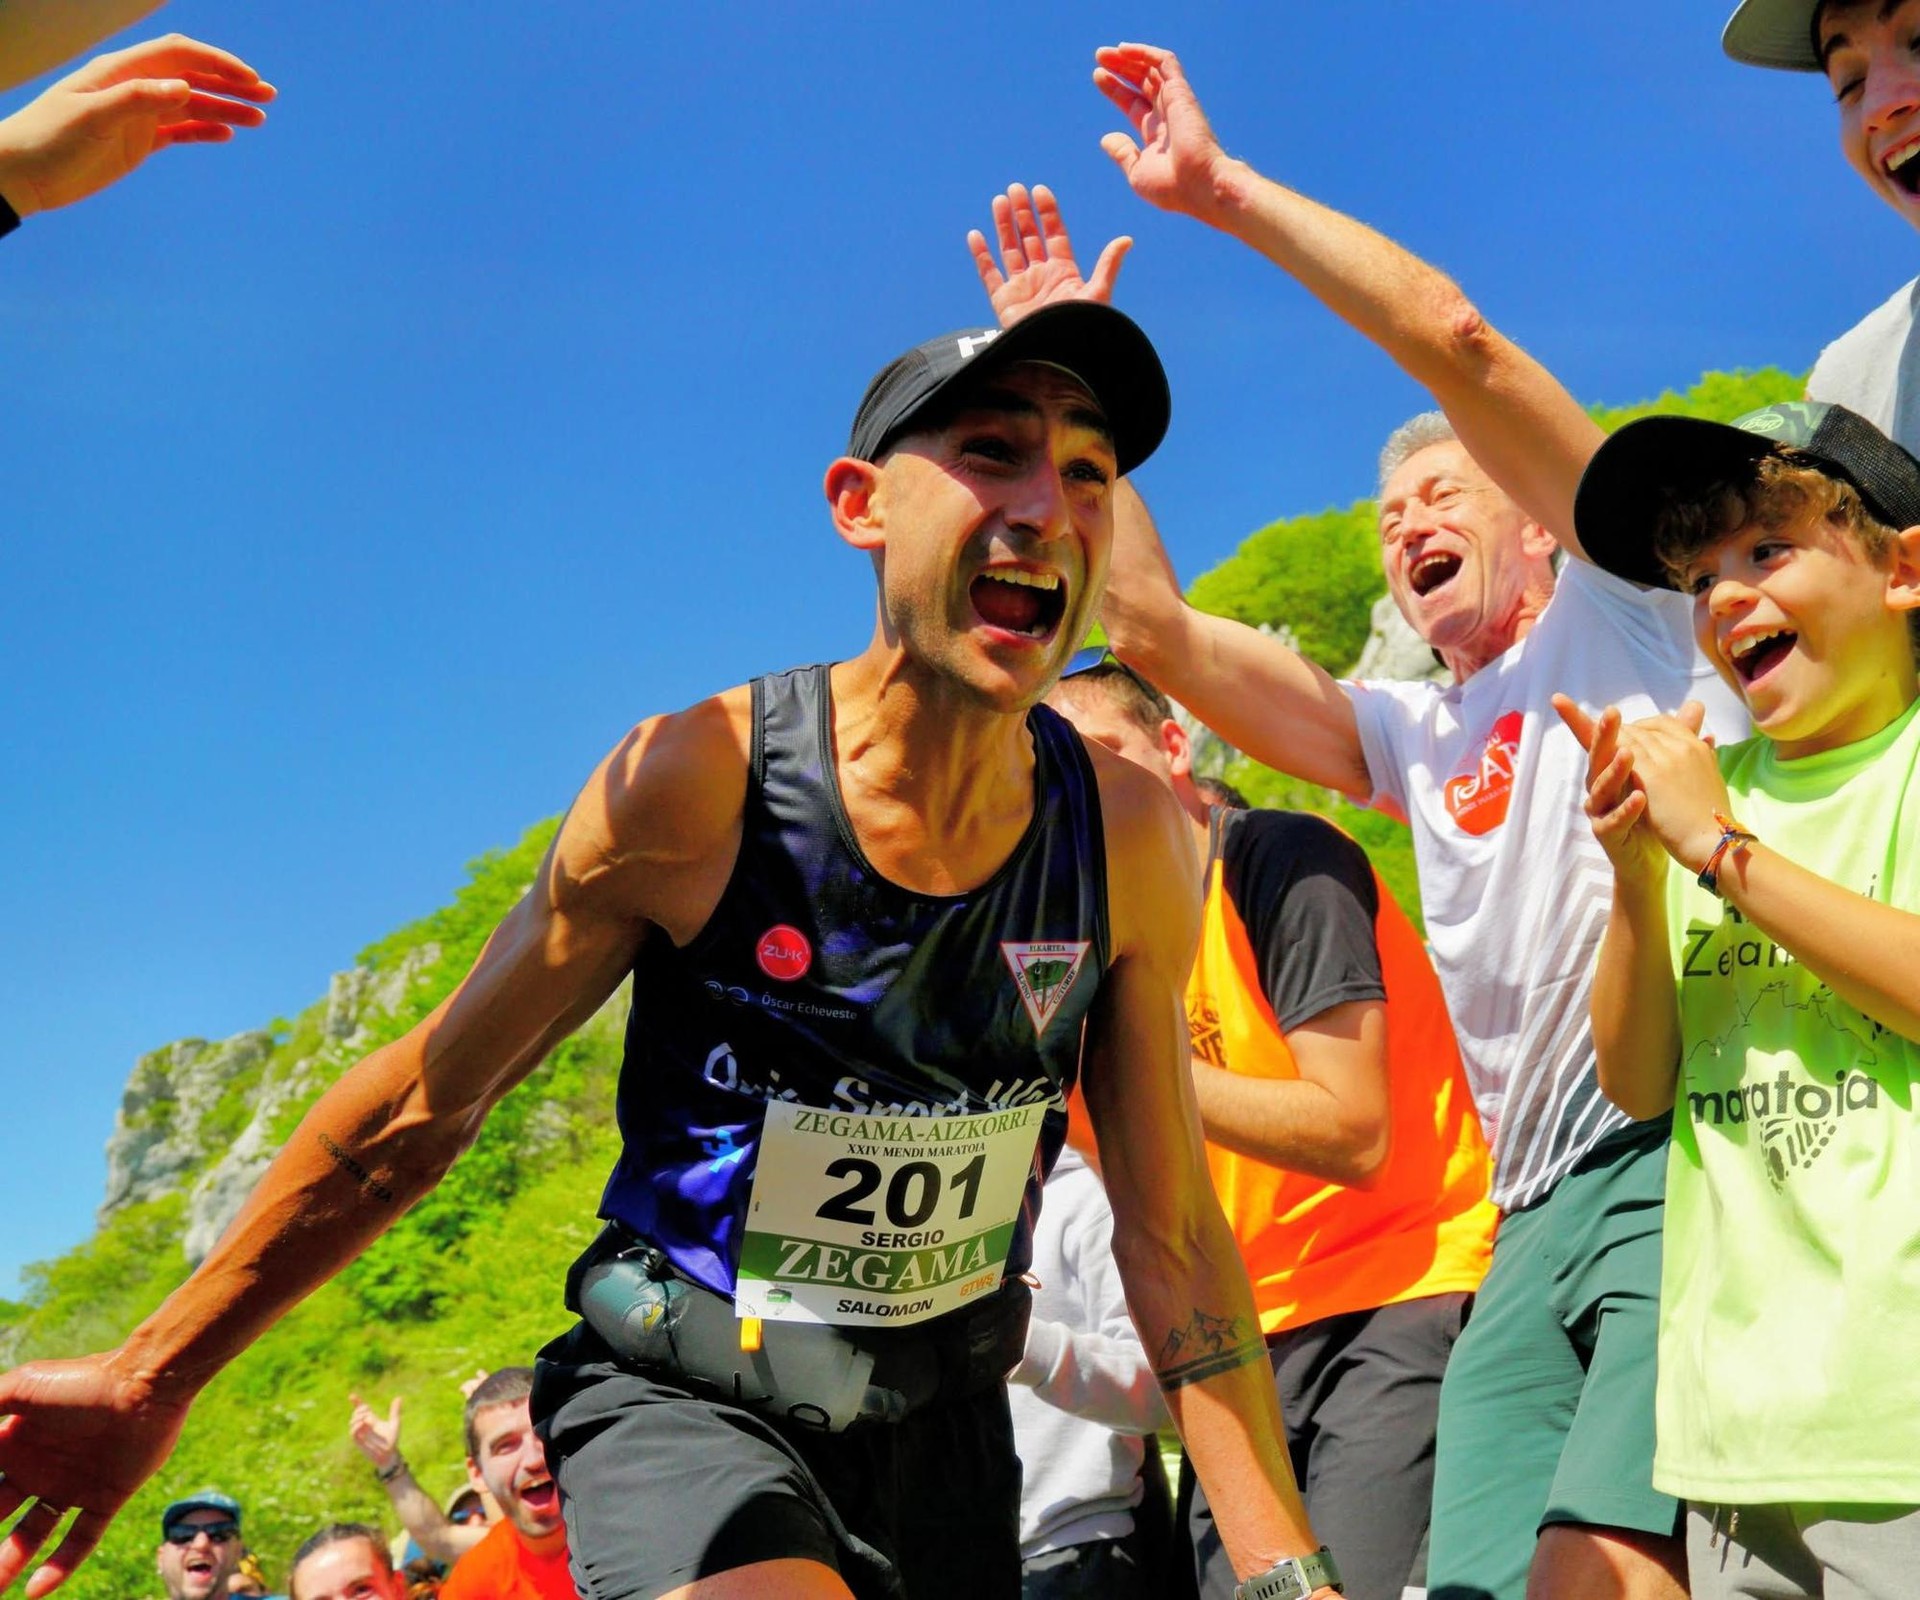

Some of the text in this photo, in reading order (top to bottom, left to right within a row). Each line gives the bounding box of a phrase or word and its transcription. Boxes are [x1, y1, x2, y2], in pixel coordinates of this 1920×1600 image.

[761, 992, 857, 1020] Óscar Echeveste
[1687, 1070, 1878, 1125] maratoia
[794, 1109, 1030, 1142] ZEGAMA-AIZKORRI
[847, 1142, 985, 1158] XXIV MENDI MARATOIA
[815, 1154, 986, 1228] 201
[861, 1229, 944, 1248] SERGIO
[774, 1236, 988, 1290] ZEGAMA
[959, 1272, 995, 1297] GTWS
[837, 1298, 934, 1317] SALOMON
